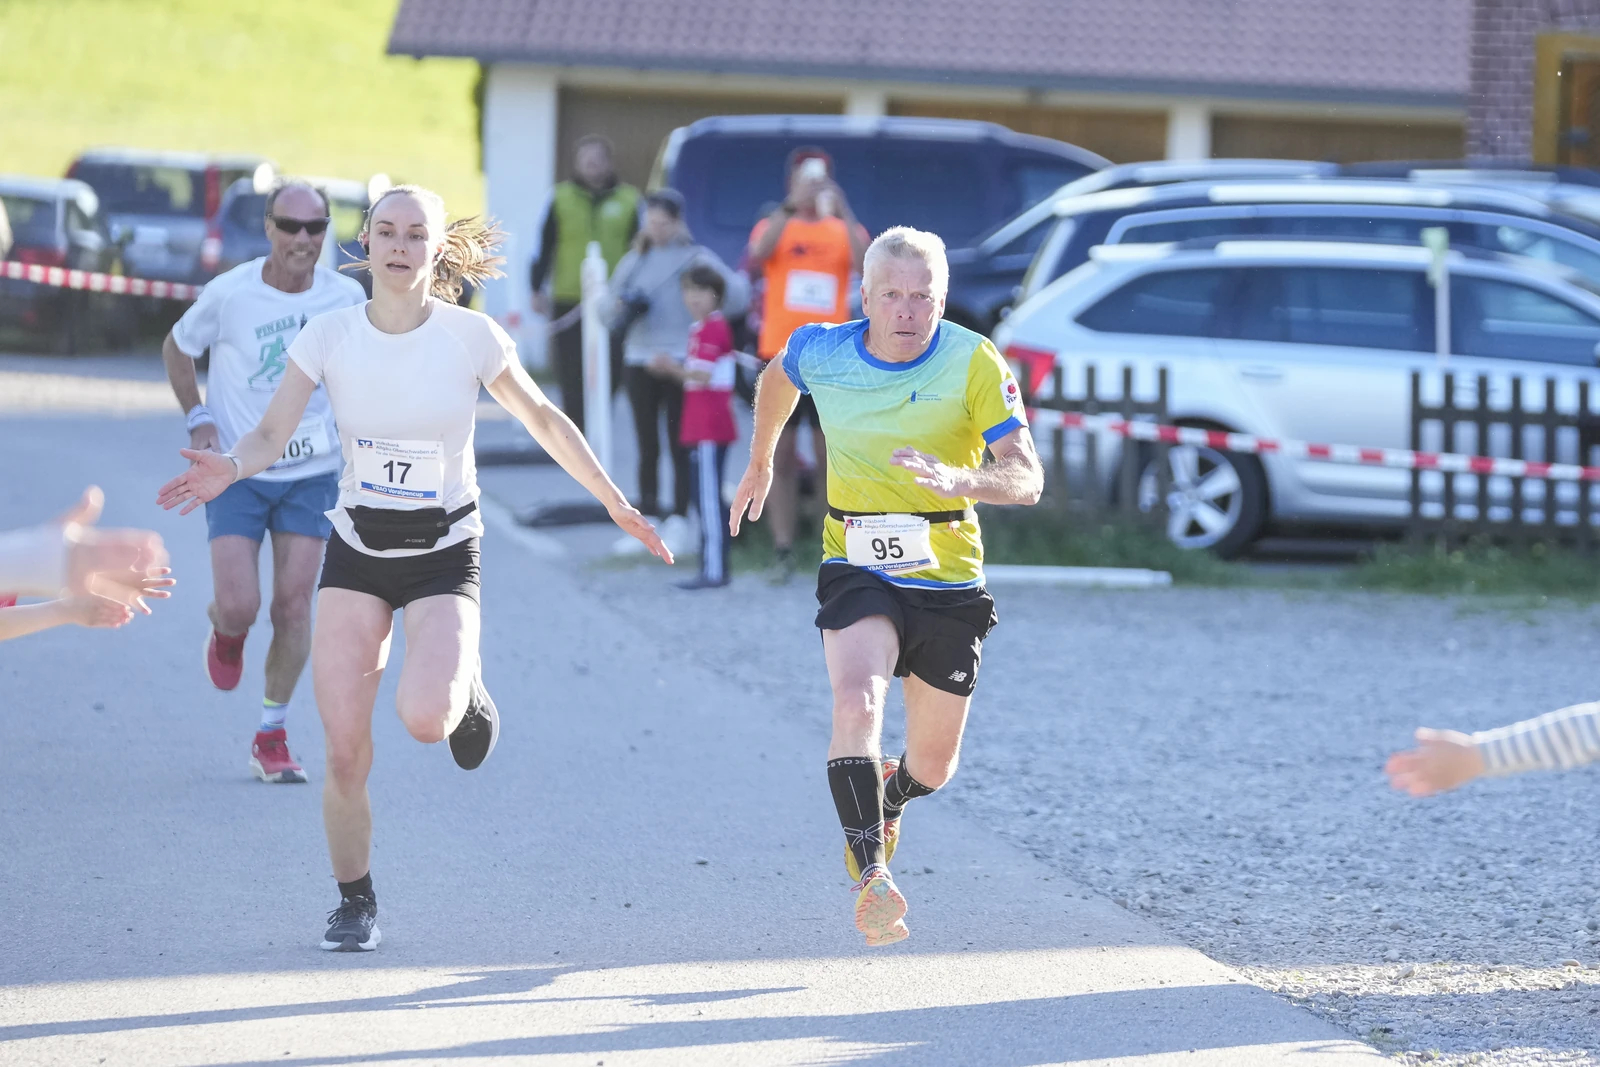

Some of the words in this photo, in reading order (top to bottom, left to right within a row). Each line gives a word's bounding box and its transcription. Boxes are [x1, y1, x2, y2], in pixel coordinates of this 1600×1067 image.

[254, 313, 297, 340] FINALE
[383, 460, 412, 484] 17
[387, 488, 424, 498] Voralpencup
[871, 537, 904, 560] 95
[885, 561, 919, 569] Voralpencup
